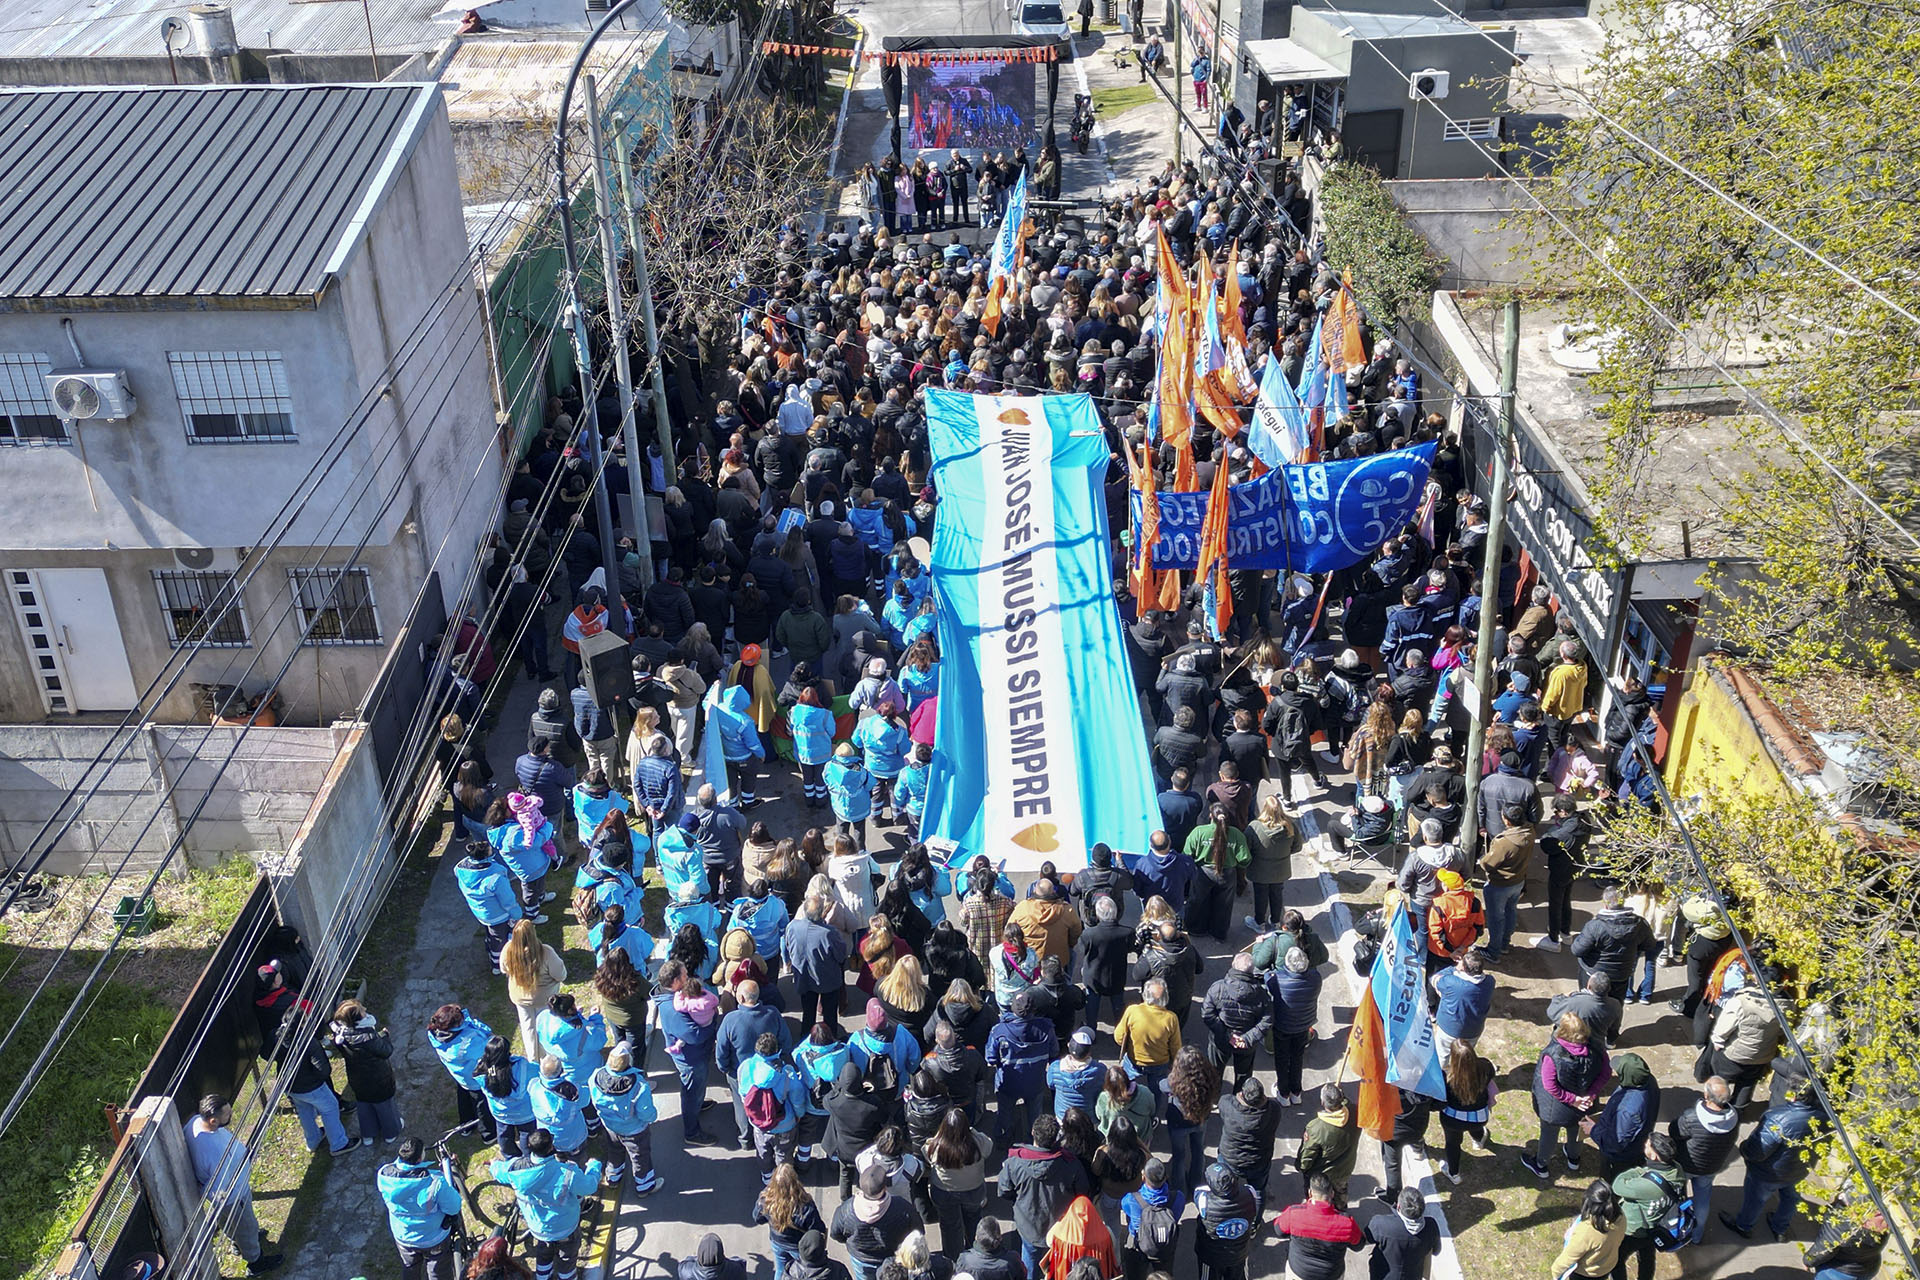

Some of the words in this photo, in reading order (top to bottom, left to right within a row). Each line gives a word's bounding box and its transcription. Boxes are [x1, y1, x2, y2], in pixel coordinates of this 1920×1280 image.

[1001, 429, 1031, 471] JUAN
[1004, 469, 1040, 552] JOSÉ
[1003, 551, 1039, 666] MUSSI
[1008, 669, 1053, 818] SIEMPRE
